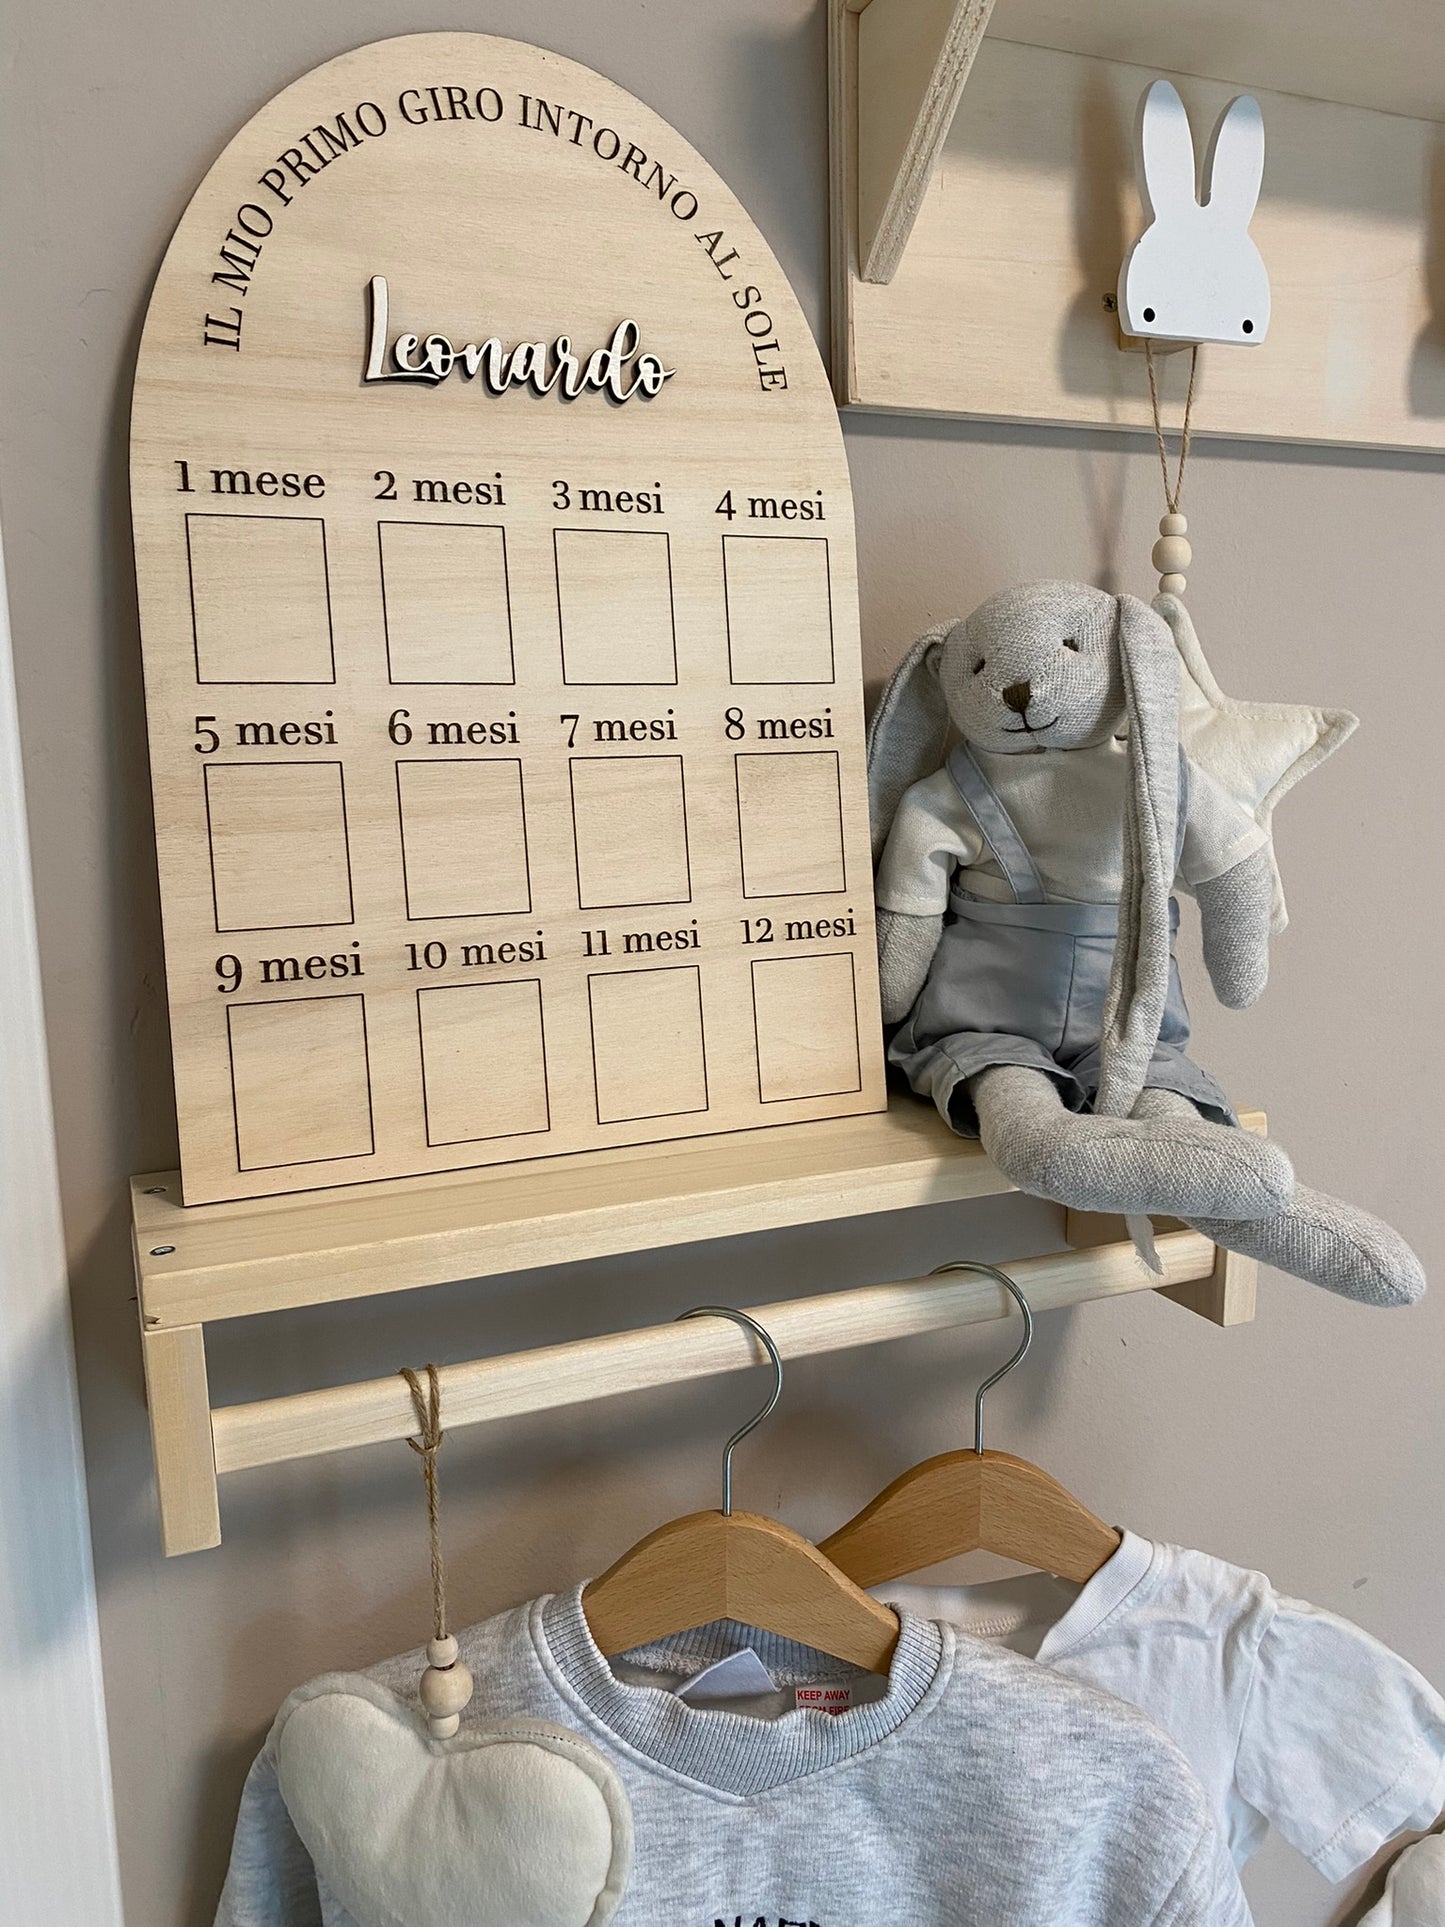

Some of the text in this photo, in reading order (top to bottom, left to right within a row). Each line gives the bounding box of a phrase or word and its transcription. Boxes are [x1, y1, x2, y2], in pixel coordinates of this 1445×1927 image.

[204, 86, 789, 392] IL MIO PRIMO GIRO INTORNO AL SOLE
[361, 274, 676, 405] Leonardo
[174, 461, 326, 499] 1 mese
[374, 471, 505, 506] 2 mesi
[552, 480, 665, 515] 3 mesi
[715, 489, 825, 521] 4 mesi
[195, 709, 337, 754] 5 mesi
[388, 708, 521, 745] 6 mesi
[560, 709, 679, 748] 7 mesi
[725, 706, 834, 740] 8 mesi
[580, 919, 702, 958] 11 mesi
[739, 908, 858, 944] 12 mesi
[215, 941, 366, 993] 9 mesi
[404, 930, 547, 972] 10 mesi
[797, 1690, 850, 1700] KEEP AWAY
